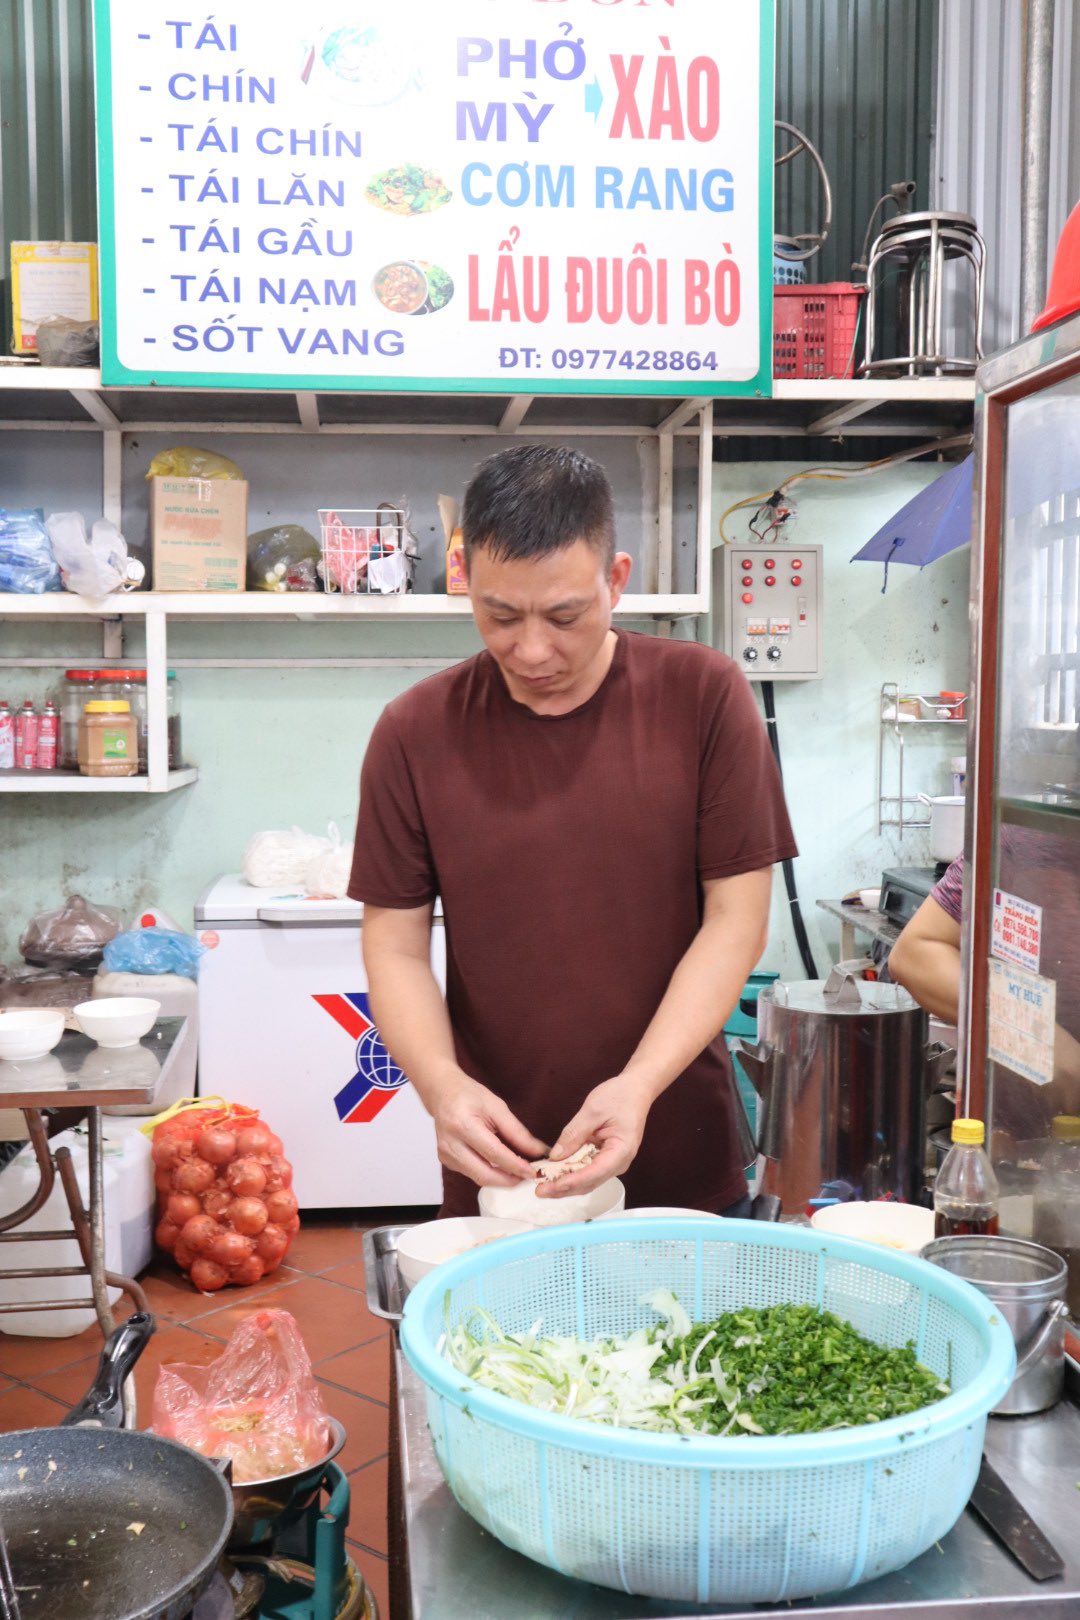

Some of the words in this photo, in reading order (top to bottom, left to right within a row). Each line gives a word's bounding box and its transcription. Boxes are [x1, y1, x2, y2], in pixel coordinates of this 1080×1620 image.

[166, 16, 237, 51] TÁI
[456, 22, 586, 80] PHỞ
[168, 69, 275, 104] CHÍN
[609, 36, 720, 142] XÀO
[168, 118, 238, 153] TÁI
[256, 123, 361, 157] CHÍN
[457, 92, 553, 142] MỲ
[169, 169, 239, 203] TÁI
[258, 172, 344, 207] LĂN
[461, 161, 574, 208] CƠM
[596, 166, 734, 213] RANG
[170, 219, 240, 253] TÁI
[258, 218, 352, 256] GẦU
[171, 269, 240, 303] TÁI
[259, 278, 356, 312] NẠM
[469, 226, 549, 323] LẨU
[565, 243, 668, 325] ĐUÔI
[685, 242, 740, 327] BÒ
[173, 315, 263, 352] SỐT
[278, 328, 404, 356] VANG
[500, 348, 540, 368] ĐT:
[552, 349, 717, 371] 0977428864
